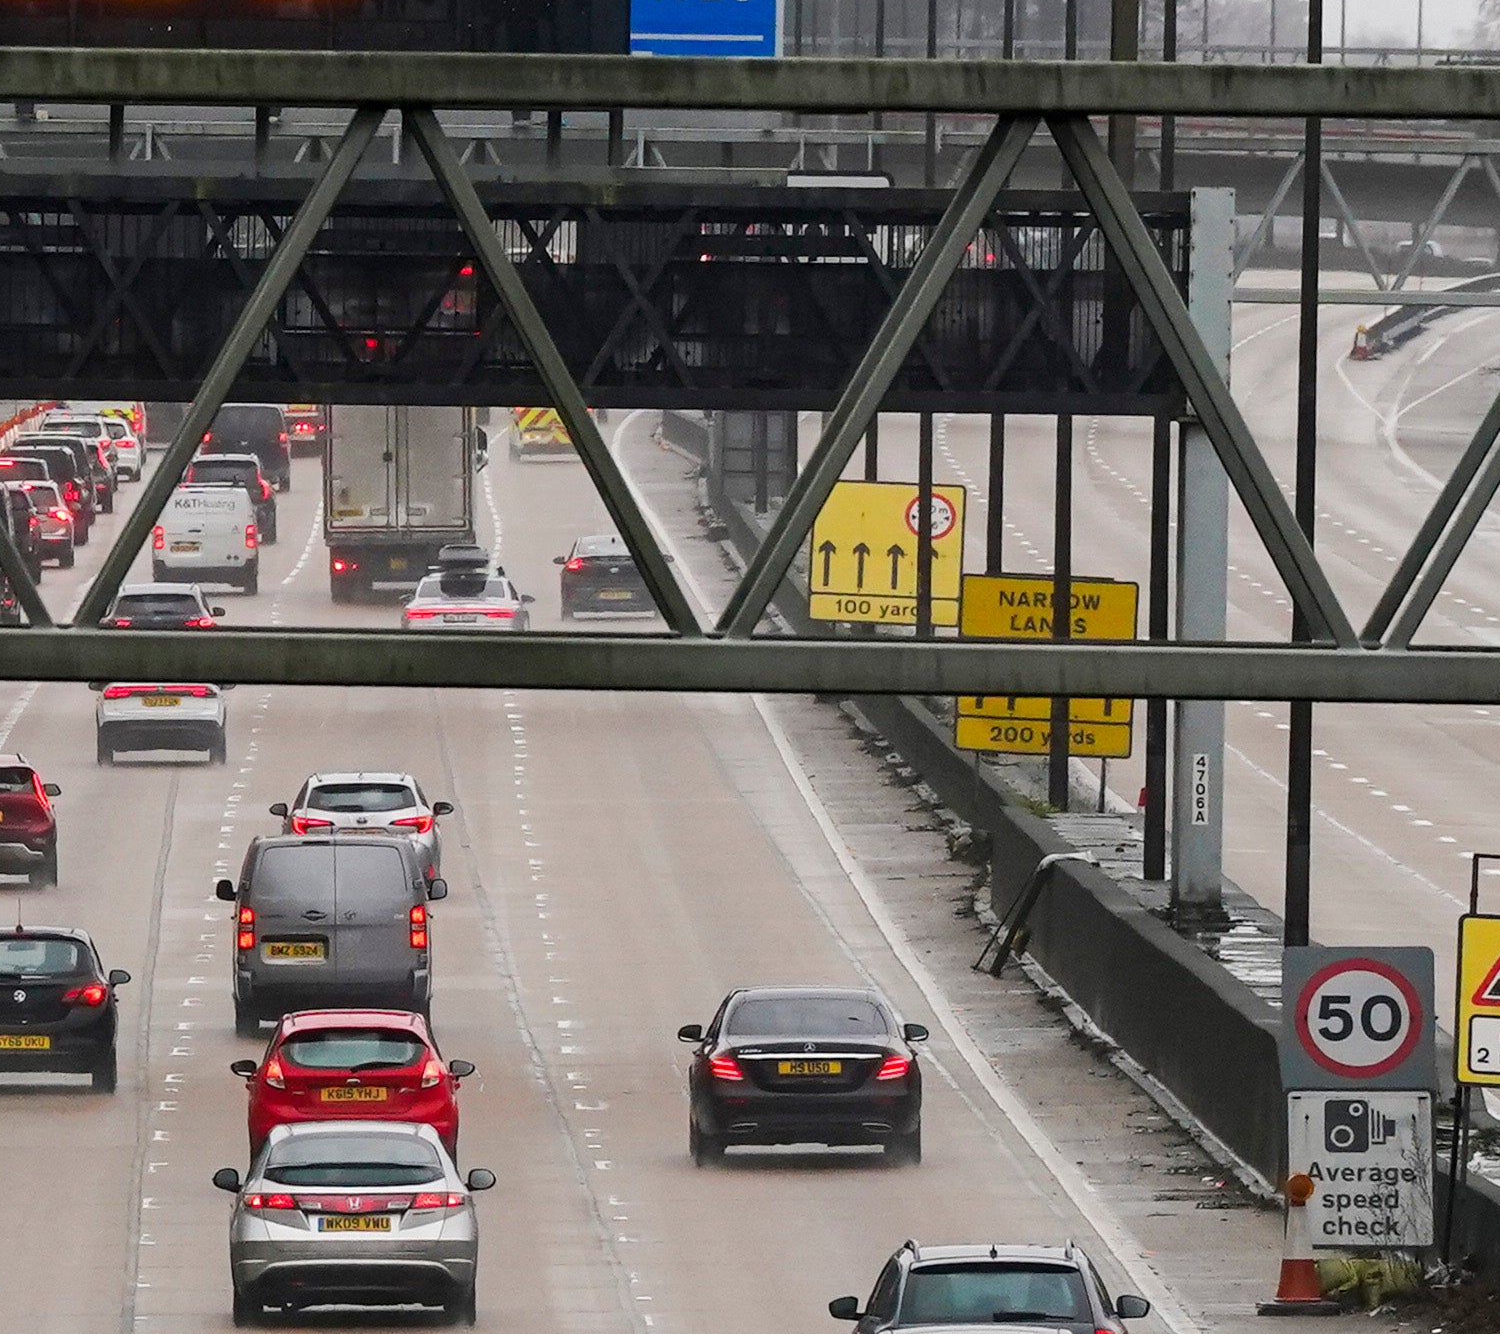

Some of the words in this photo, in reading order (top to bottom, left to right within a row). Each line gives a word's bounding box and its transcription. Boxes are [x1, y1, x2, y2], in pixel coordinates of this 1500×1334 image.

[835, 598, 871, 615] 100
[998, 589, 1101, 611] NAROW
[1010, 614, 1088, 635] LANS
[989, 725, 1034, 743] 200
[1194, 755, 1207, 824] 4706A
[1316, 993, 1402, 1043] 50
[1476, 1047, 1490, 1065] 2
[1307, 1161, 1417, 1186] Average
[1321, 1189, 1400, 1214] speed
[325, 1216, 361, 1230] WK09
[1321, 1214, 1401, 1237] check
